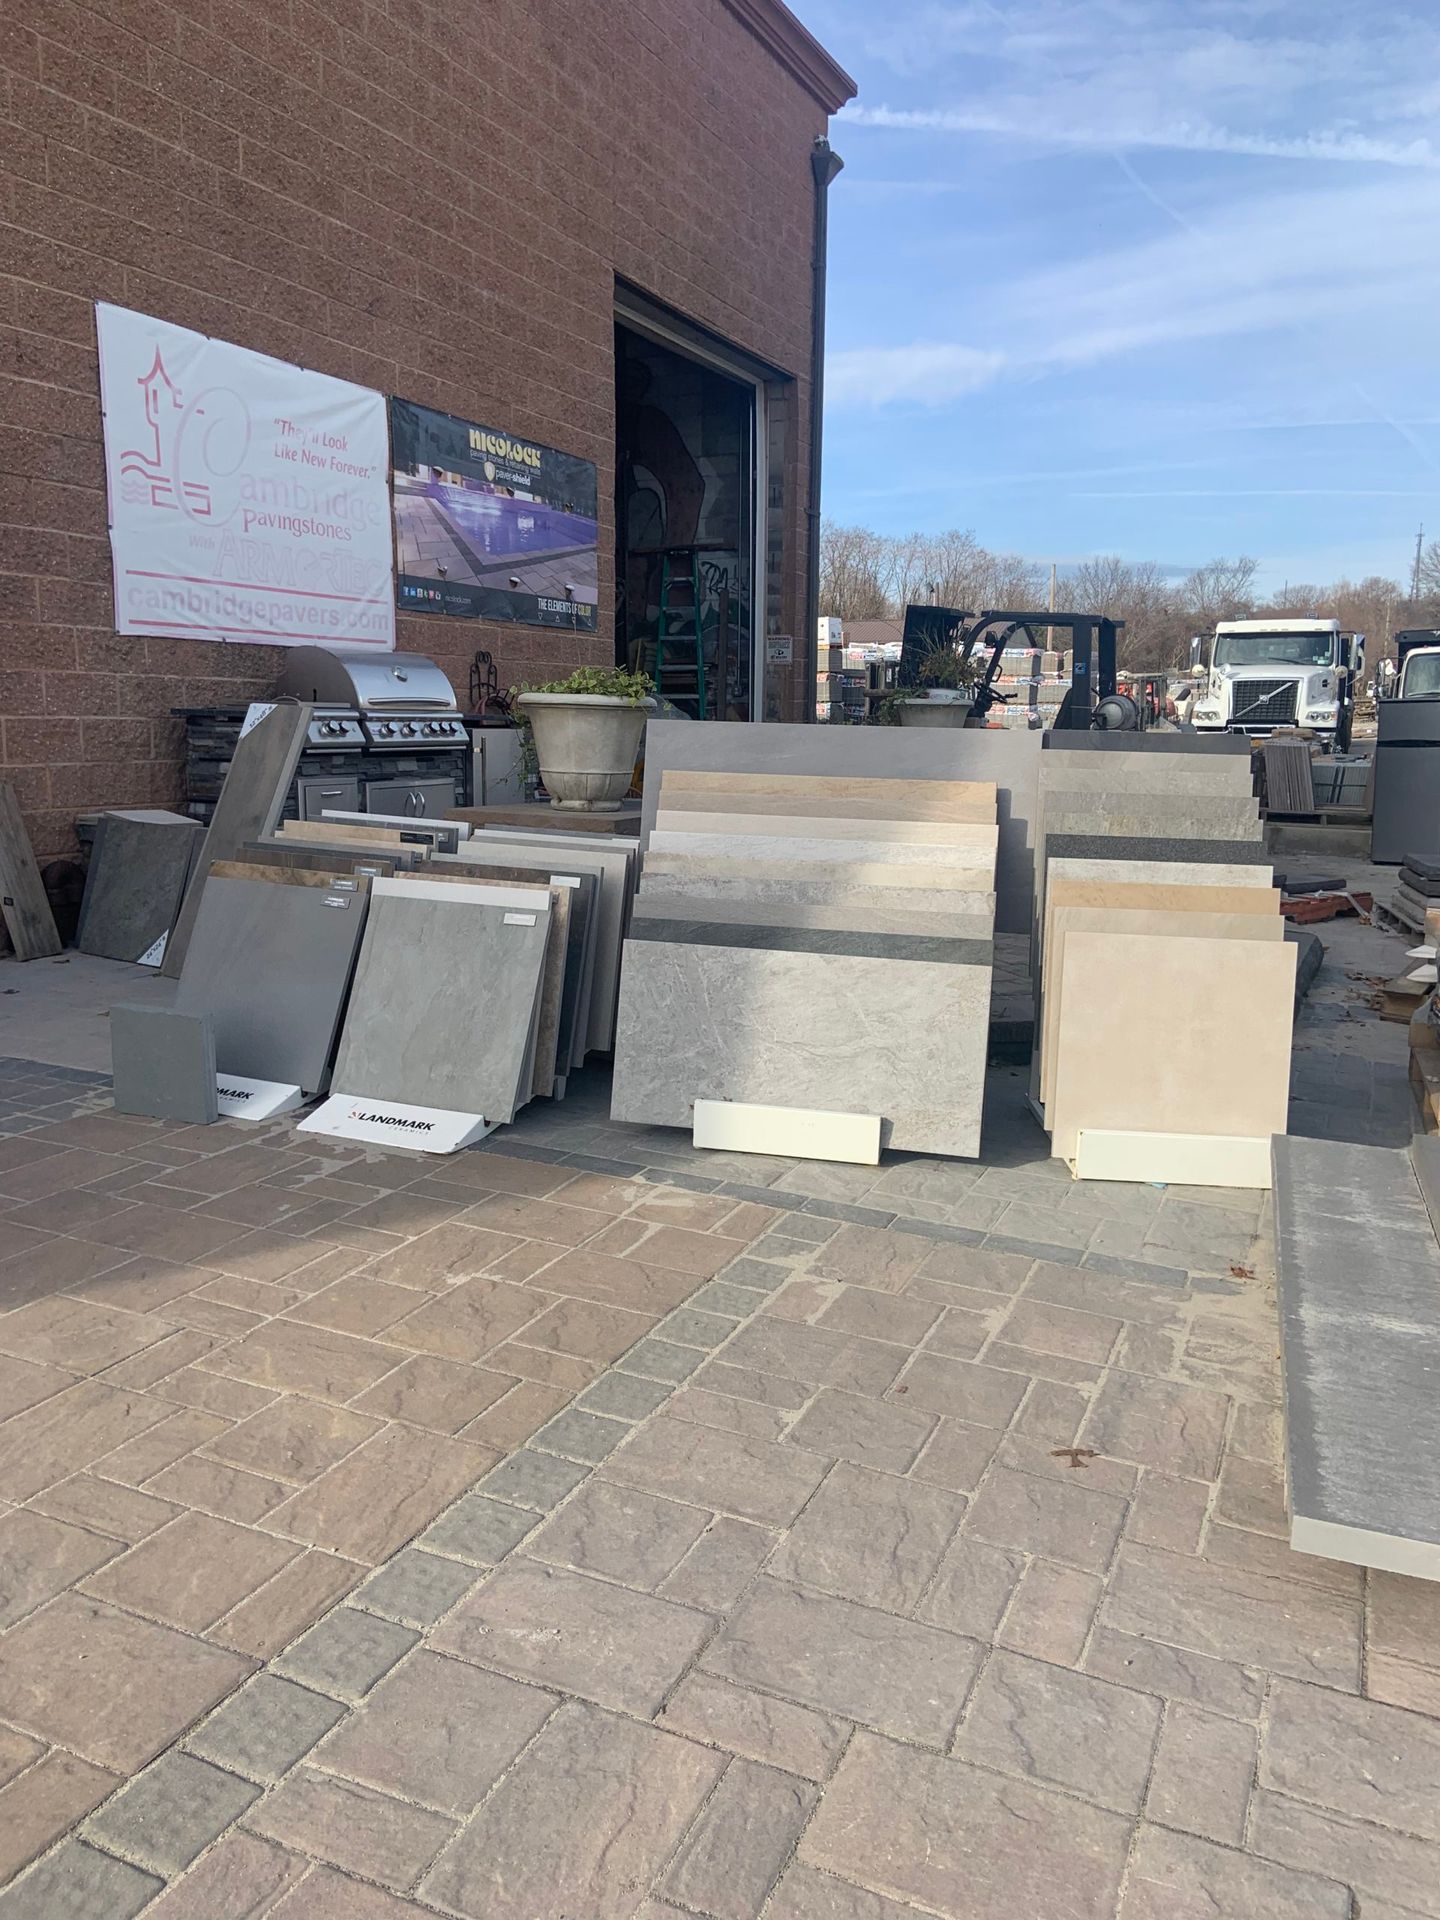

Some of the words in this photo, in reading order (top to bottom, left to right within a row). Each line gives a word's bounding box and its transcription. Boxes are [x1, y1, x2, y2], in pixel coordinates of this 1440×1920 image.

[322, 432, 348, 451] Look
[469, 429, 541, 468] NICOLOCK
[274, 443, 298, 461] Like
[301, 449, 327, 468] New
[330, 456, 376, 479] Forever."
[243, 508, 352, 541] Pavingstones
[127, 585, 389, 631] cambridgepavers.com
[538, 597, 548, 610] THE
[548, 600, 571, 613] ELEMENTS
[216, 1088, 255, 1100] MARK
[358, 1112, 436, 1131] LANDMARK
